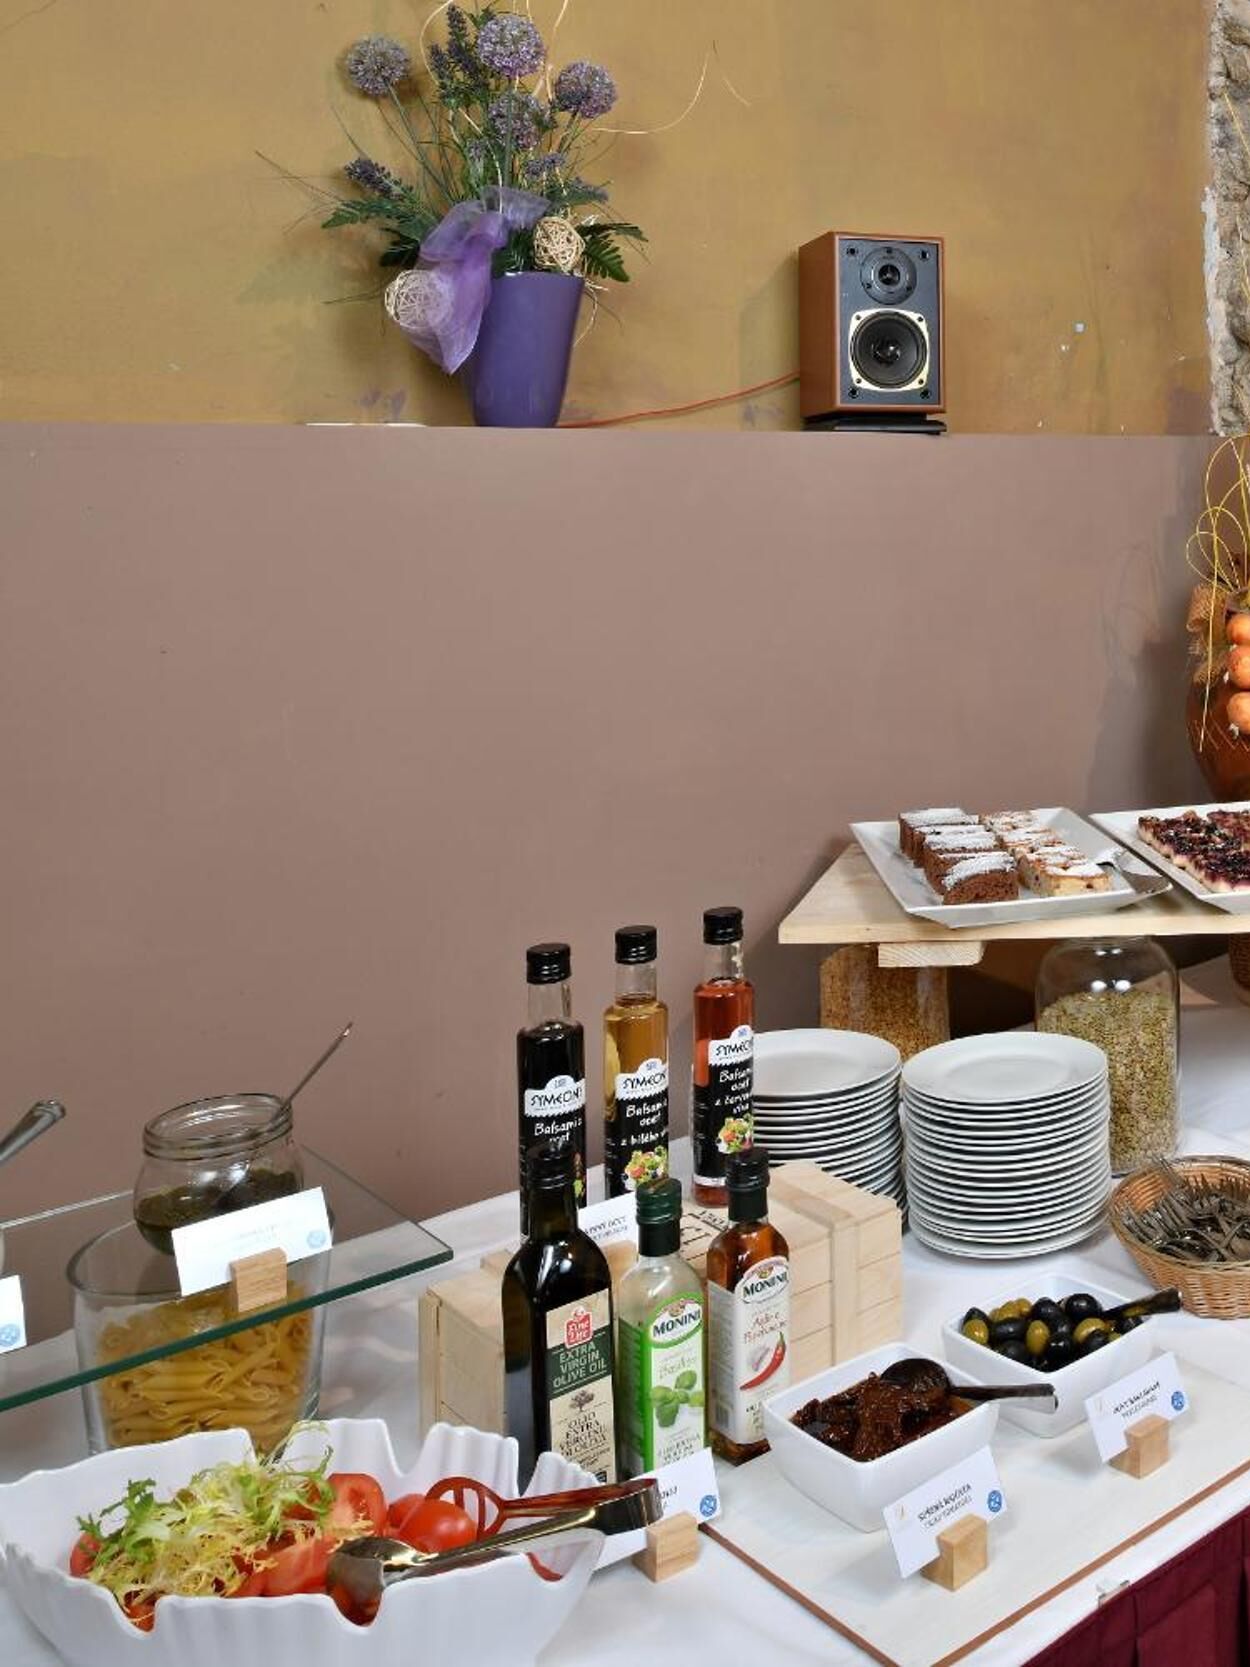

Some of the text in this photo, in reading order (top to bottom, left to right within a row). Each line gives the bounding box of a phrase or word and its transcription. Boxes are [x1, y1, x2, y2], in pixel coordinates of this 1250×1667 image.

[559, 1341, 597, 1363] EXTRA
[560, 1350, 600, 1374] VIRGIN
[552, 1357, 607, 1388] OLIVE OIL
